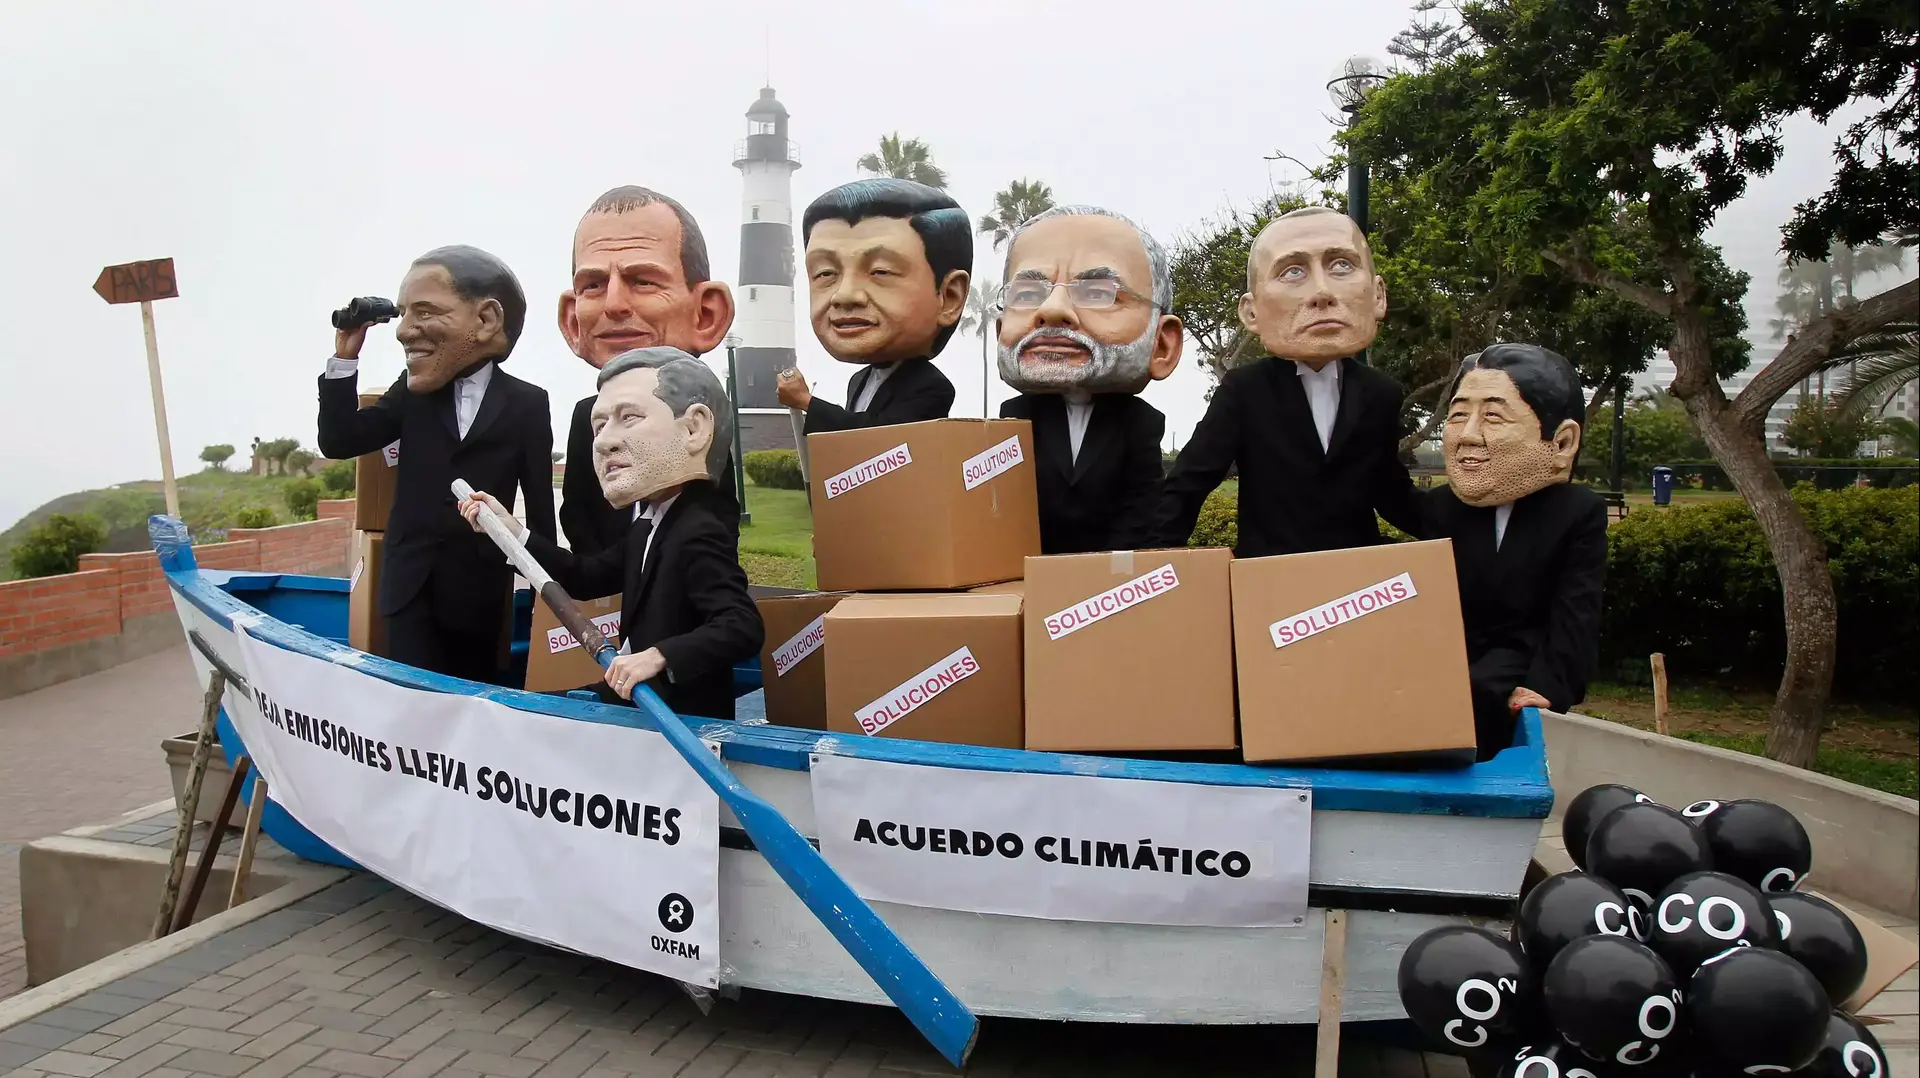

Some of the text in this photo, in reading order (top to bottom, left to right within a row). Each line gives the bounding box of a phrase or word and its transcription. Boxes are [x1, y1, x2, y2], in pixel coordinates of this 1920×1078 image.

[110, 260, 174, 300] PARIS
[830, 450, 907, 495] SOLUTIONS
[965, 444, 1019, 483] SOLUTIONS
[1046, 569, 1176, 636] SOLUCIONES
[1278, 581, 1408, 643] SOLUTIONS
[775, 625, 825, 671] SOLUCIONE
[861, 656, 977, 733] SOLUCIONES
[284, 708, 392, 772] EMISIONES
[396, 746, 469, 795] LLEVA
[476, 766, 682, 846] SOLUCIONES
[853, 818, 1252, 878] ACUERDO CLIMÁTICO
[651, 935, 700, 961] OXFAM
